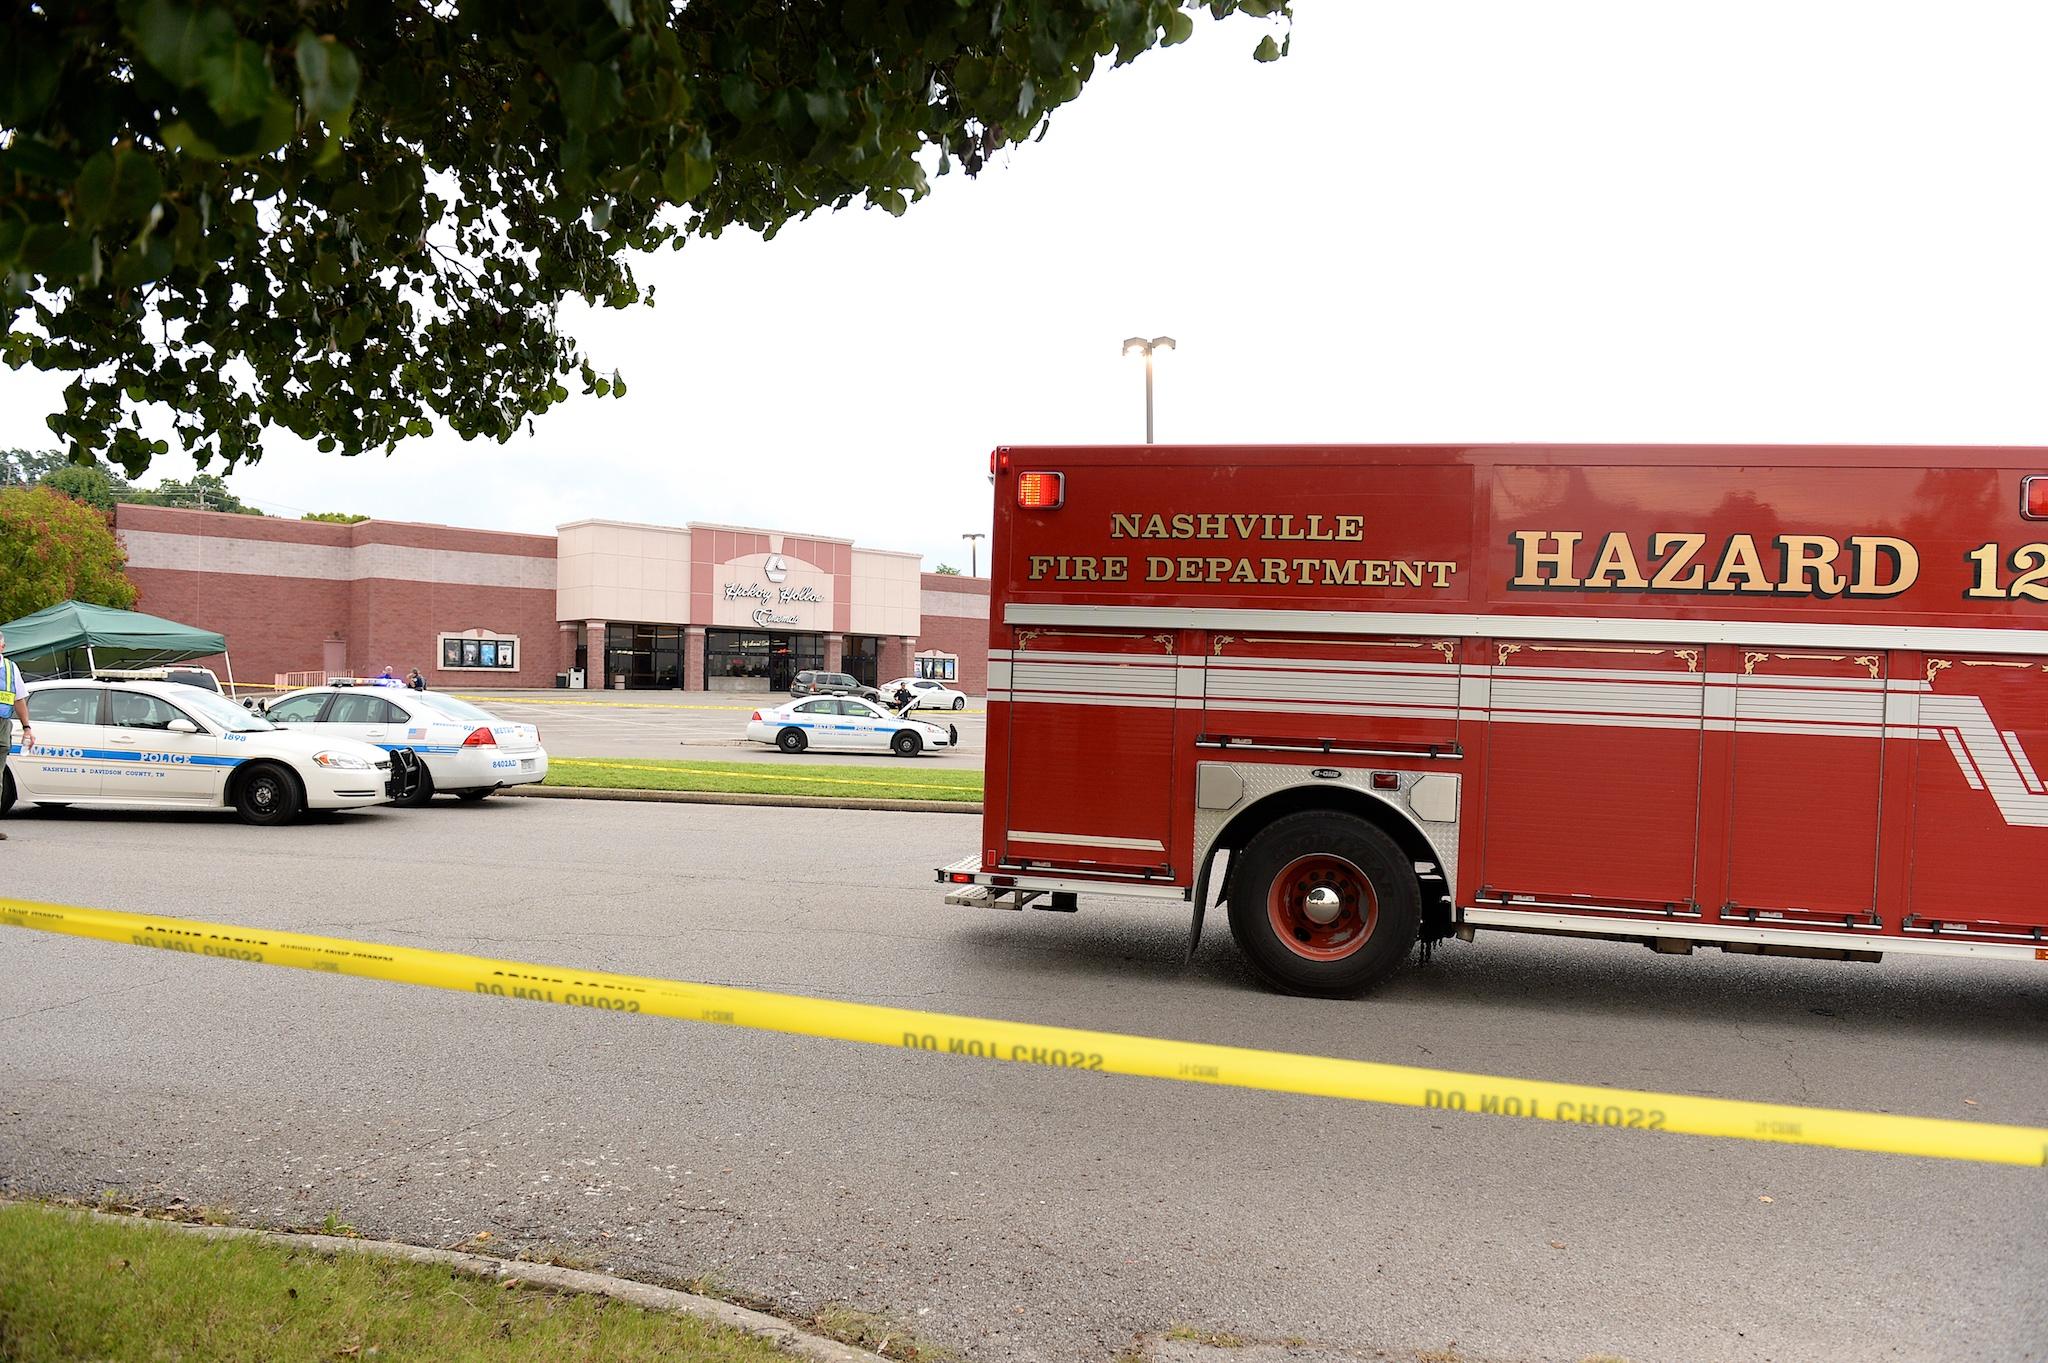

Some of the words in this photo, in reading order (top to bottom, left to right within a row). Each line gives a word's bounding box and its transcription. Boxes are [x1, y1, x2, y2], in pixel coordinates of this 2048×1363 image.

[1109, 513, 1365, 542] NASHVILLE
[1028, 555, 1129, 582] FIRE
[1145, 556, 1458, 590] DEPARTMENT
[1507, 530, 1920, 599] HAZARD
[724, 583, 772, 606] Hickory
[223, 732, 247, 742] 1898
[32, 746, 84, 758] METRO
[140, 752, 192, 764] POLICE
[41, 766, 78, 774] NASHVILLE
[89, 768, 122, 776] DAVIDSON
